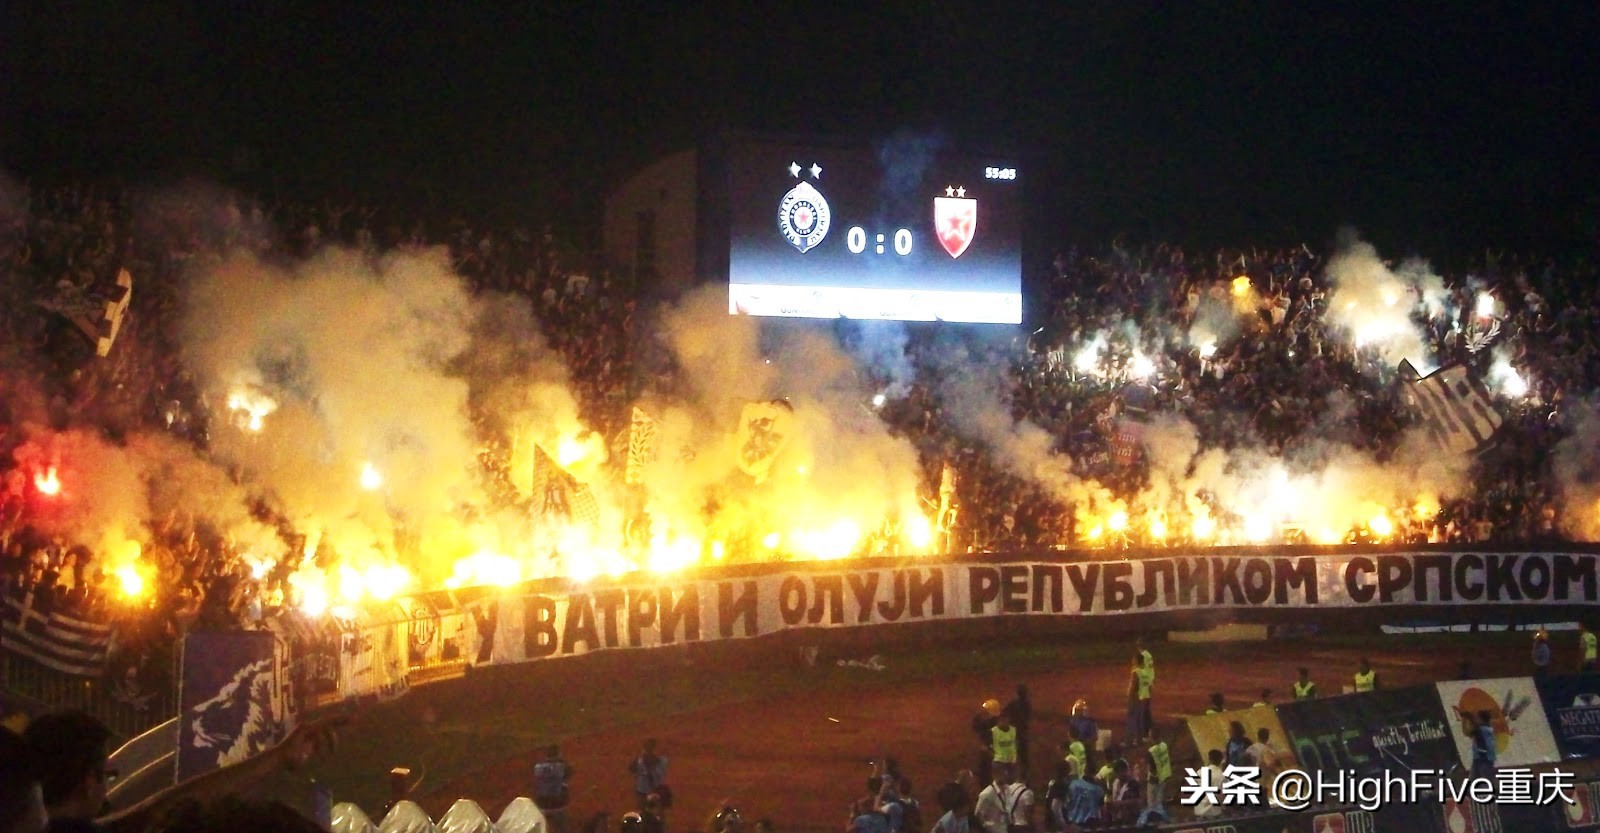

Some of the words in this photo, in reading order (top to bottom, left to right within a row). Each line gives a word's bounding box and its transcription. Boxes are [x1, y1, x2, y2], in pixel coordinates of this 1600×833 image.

[985, 166, 1017, 180] 55:05
[847, 226, 867, 254] 0
[894, 228, 913, 256] 0
[470, 603, 499, 663] У
[523, 587, 700, 658] ВАТРИ
[718, 580, 759, 639] И
[779, 566, 944, 626] ОЛУЈИ
[969, 556, 1318, 614] РЕПУБЛИКОМ
[1344, 554, 1598, 605] СРПСКОМ
